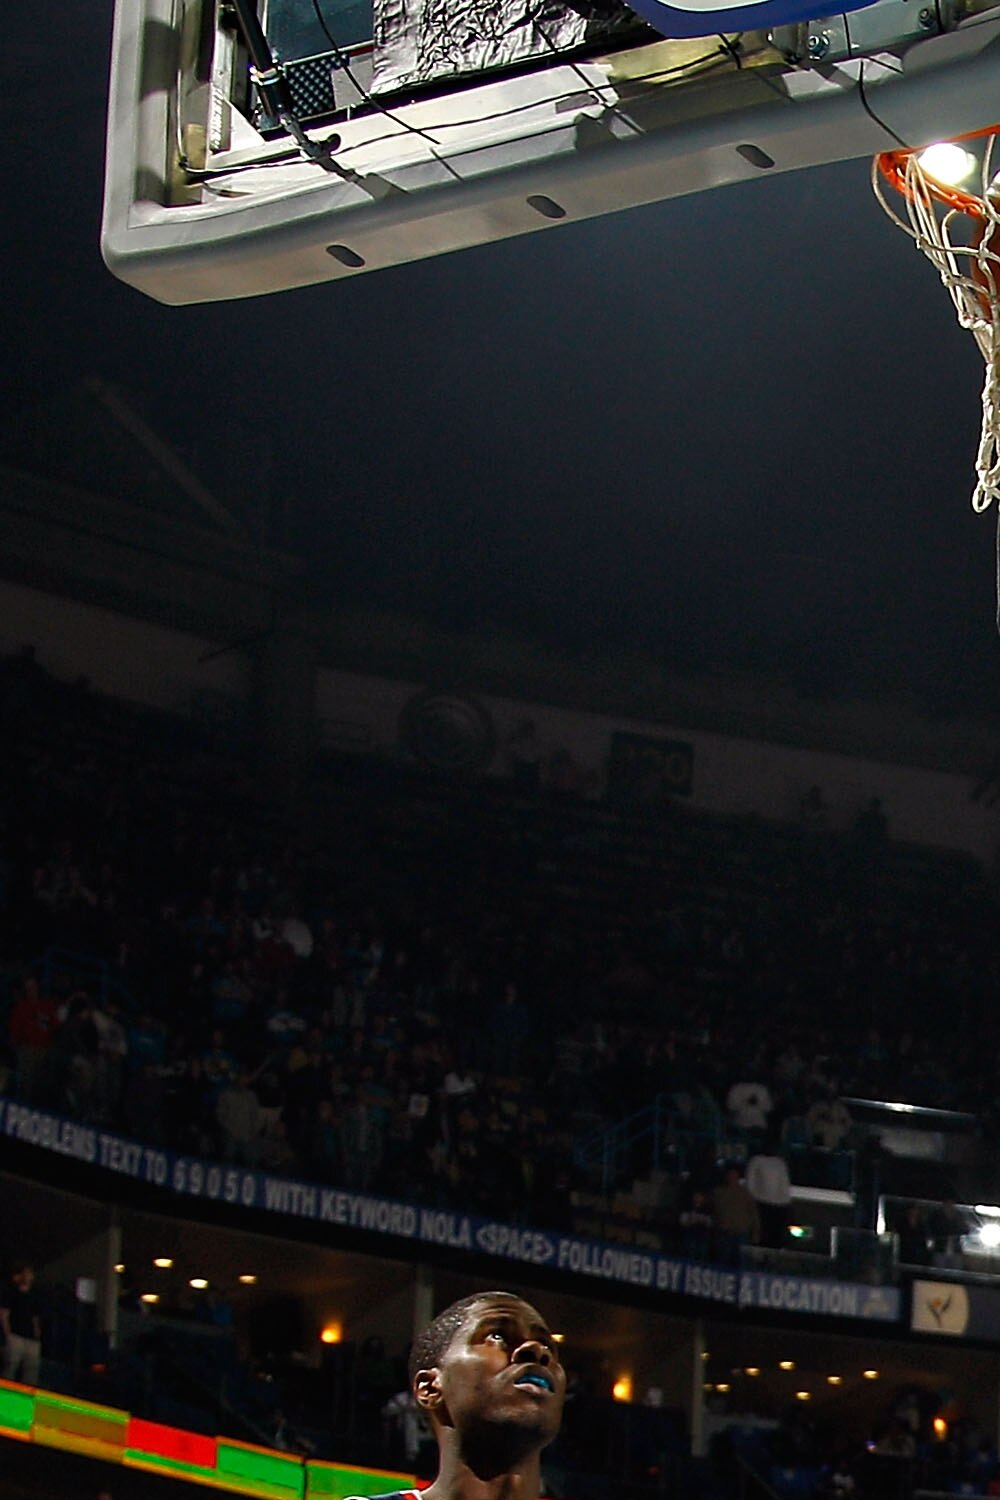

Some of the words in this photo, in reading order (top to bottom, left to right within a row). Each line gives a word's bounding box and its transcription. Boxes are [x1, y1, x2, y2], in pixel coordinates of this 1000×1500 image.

[6, 1103, 97, 1163] PROBLEMS
[100, 1133, 142, 1177] TEXT
[145, 1151, 168, 1184] TO
[265, 1178, 316, 1219] WITH
[319, 1188, 416, 1238] KEYWORD
[419, 1208, 471, 1250] NOLA
[557, 1238, 652, 1286] FOLLOWED
[656, 1260, 681, 1293] BY
[685, 1267, 738, 1303] ISSUE
[758, 1281, 858, 1316] LOCATION
